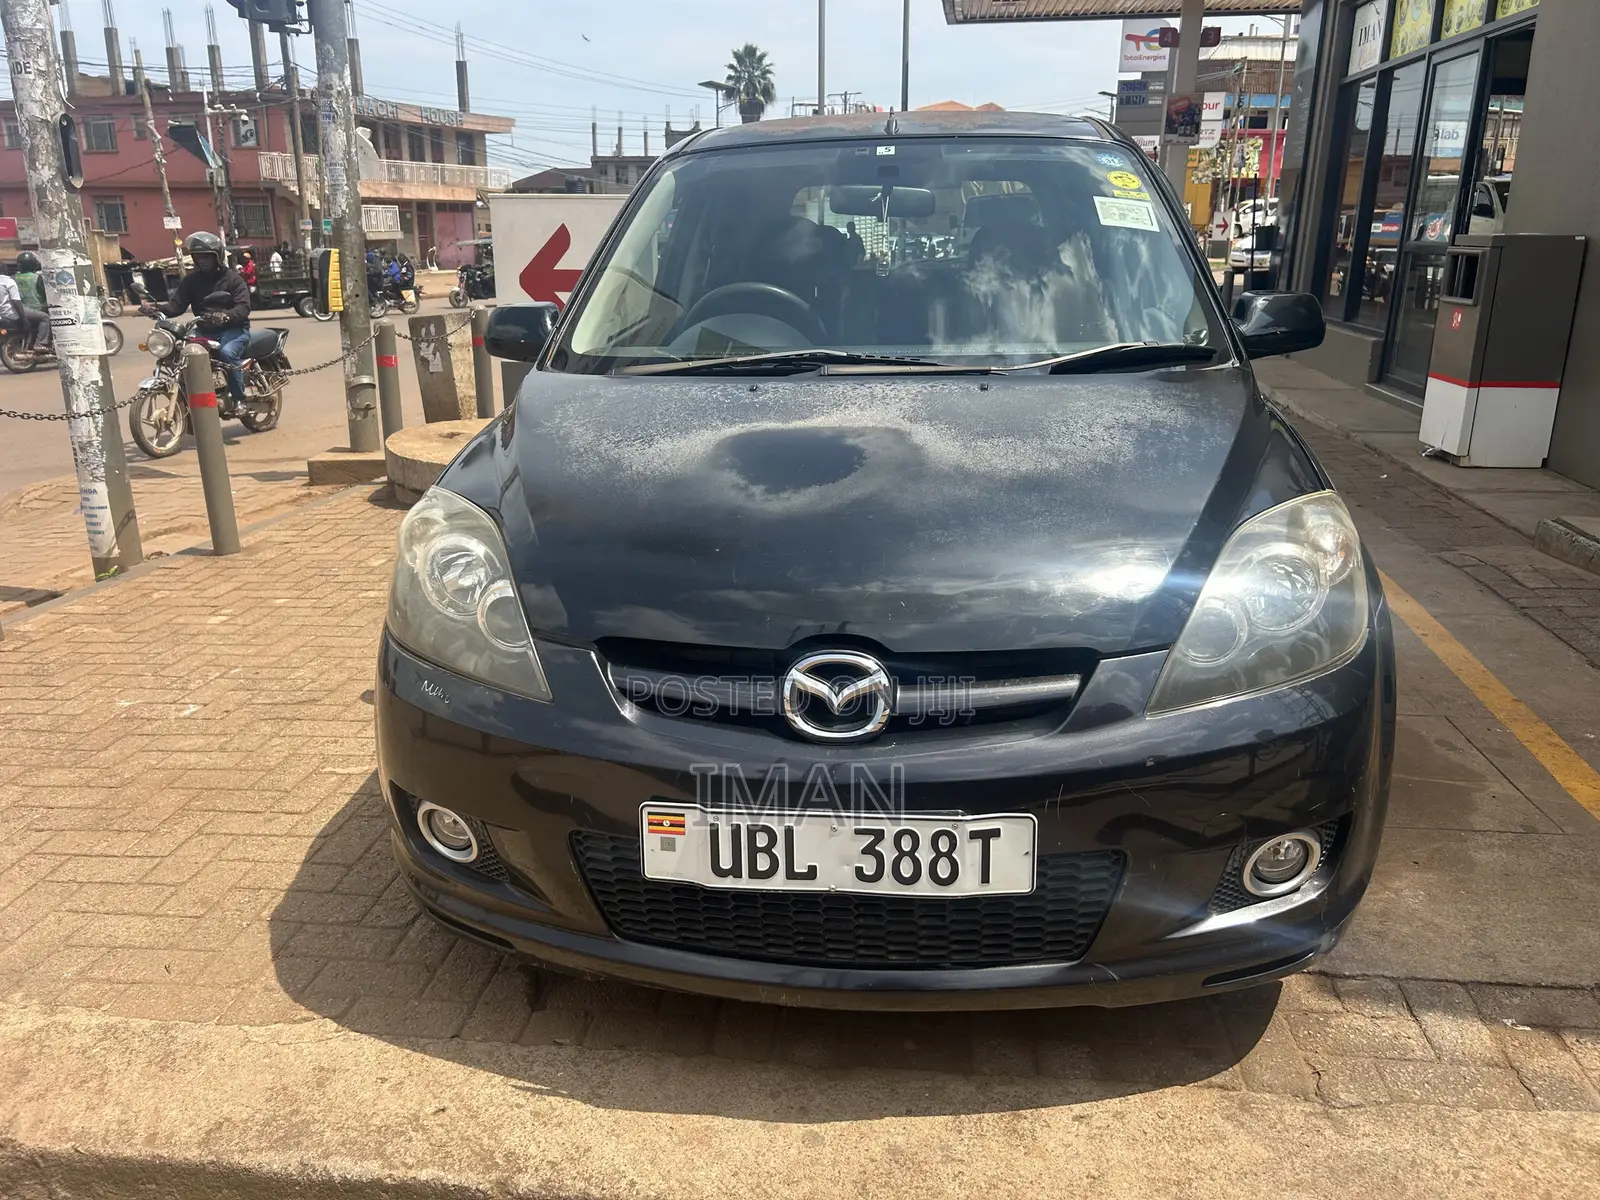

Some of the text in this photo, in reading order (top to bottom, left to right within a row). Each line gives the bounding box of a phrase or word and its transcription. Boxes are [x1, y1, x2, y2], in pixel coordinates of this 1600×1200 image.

[420, 106, 464, 128] HOUSE
[709, 820, 1001, 887] UBL 388T
